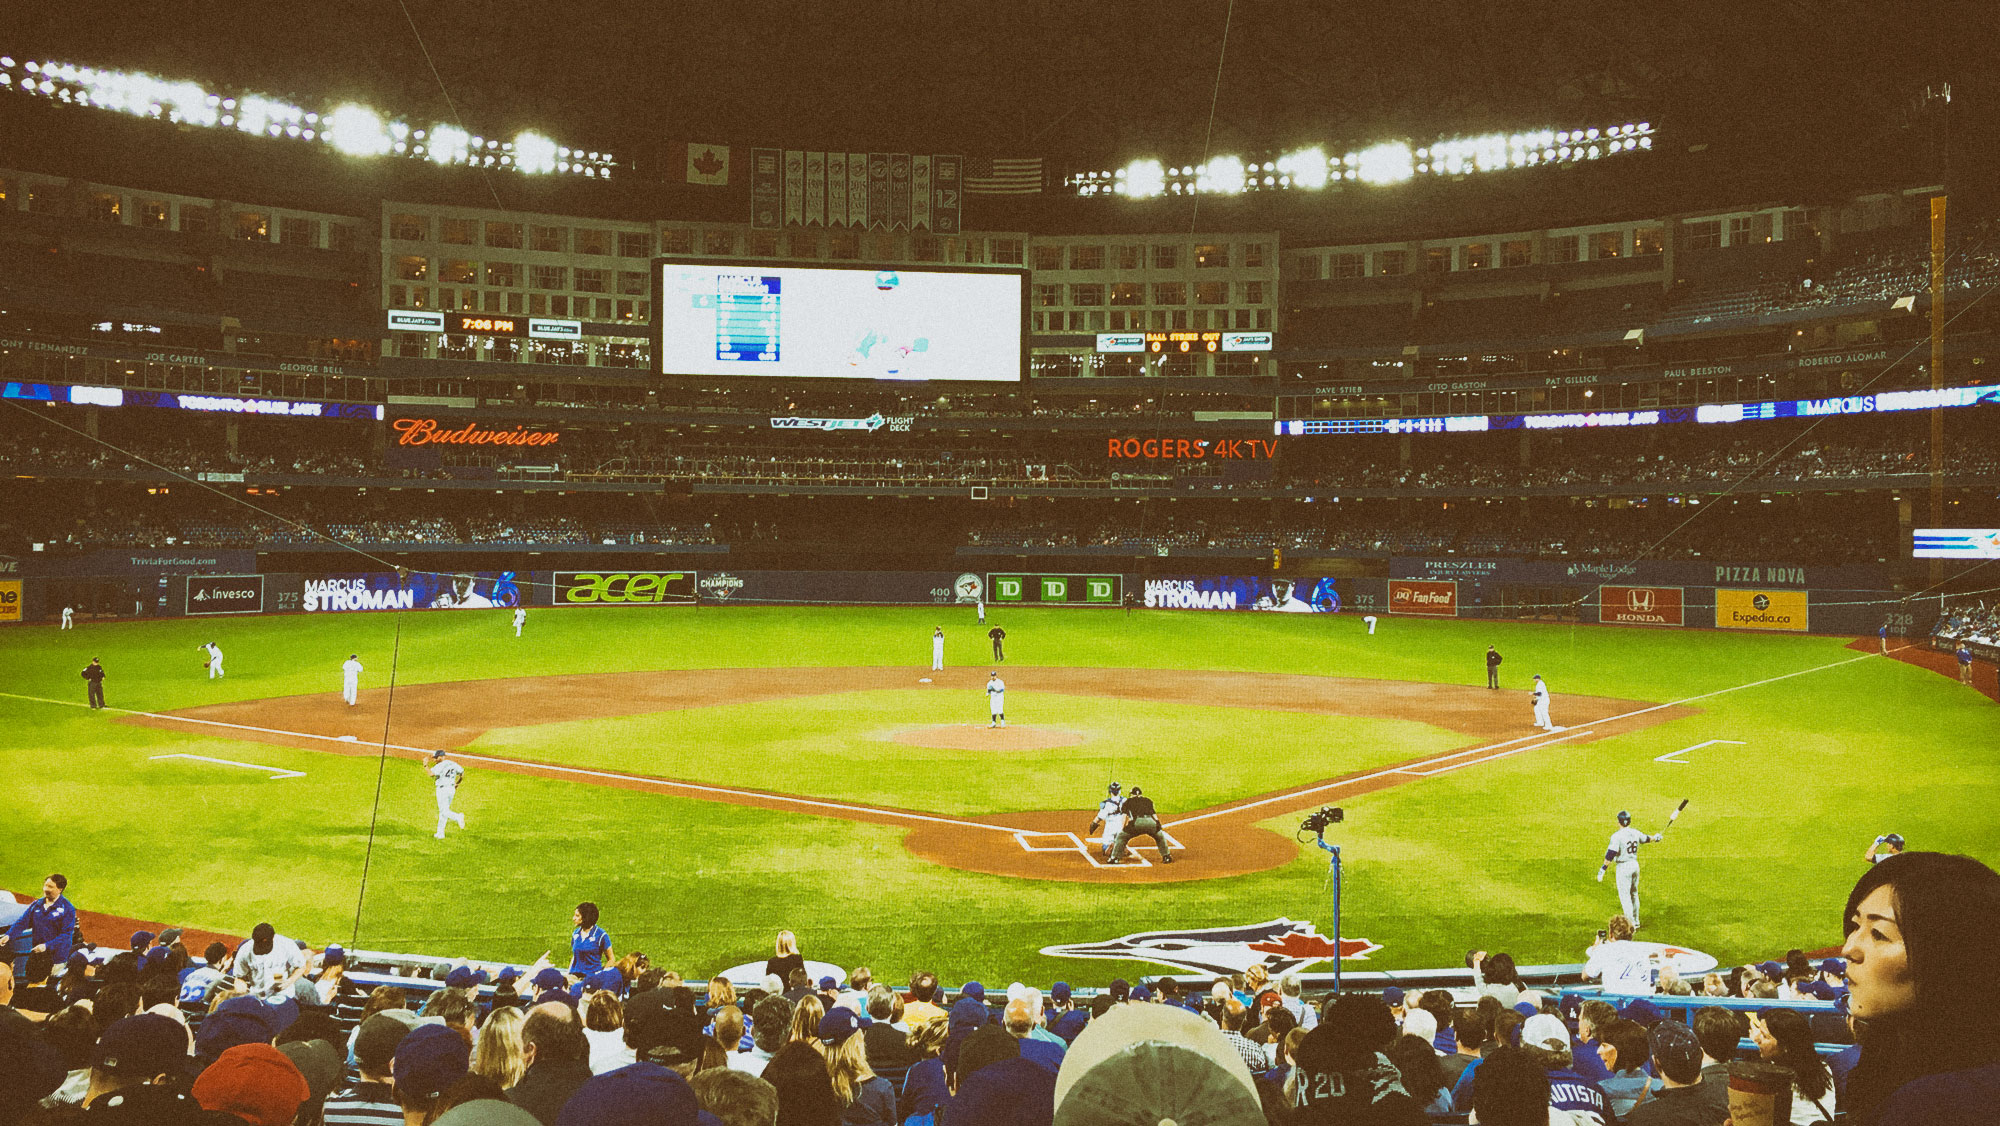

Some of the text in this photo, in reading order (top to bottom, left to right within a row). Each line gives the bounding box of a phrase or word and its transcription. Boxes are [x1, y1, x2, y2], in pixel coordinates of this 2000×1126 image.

[936, 189, 958, 209] 12
[462, 318, 514, 331] 7:06 PM
[0, 339, 88, 356] ONY FERNANDEZ
[1151, 341, 1217, 352] 0 0 0
[145, 353, 205, 365] JOE CARTER
[1798, 351, 1887, 367] ROBERTO ALOMAR
[280, 363, 344, 375] GEORGE BELL
[1664, 366, 1731, 378] PAUL BEESTON
[1428, 381, 1487, 391] CITO GASTON
[1545, 375, 1598, 386] PAT GILLICK
[1807, 396, 1874, 415] MARCUS
[772, 417, 866, 431] WESTJET
[393, 418, 560, 446] Budweiser
[1108, 438, 1205, 459] ROGERS
[1715, 566, 1805, 585] PIZZA NOVA
[305, 578, 366, 592] MARCUS
[566, 573, 684, 602] acer
[700, 579, 744, 588] CHAMPIONS
[998, 580, 1020, 597] TD
[1043, 581, 1065, 598] TD
[1088, 581, 1111, 598] TD
[1144, 579, 1194, 591] MARCUS
[212, 588, 256, 600] Invesco
[277, 591, 299, 603] 375
[930, 587, 950, 597] 400
[1396, 590, 1410, 600] DQ
[303, 589, 414, 611] STROMAN
[1144, 590, 1237, 610] STROMAN
[1355, 594, 1375, 605] 375
[1616, 613, 1665, 623] HONDA
[1732, 610, 1791, 625] Expedia.ca
[1885, 612, 1914, 626] 328
[1626, 840, 1639, 855] 26
[1314, 1072, 1347, 1099] 20
[1548, 1083, 1604, 1111] AUTISTA
